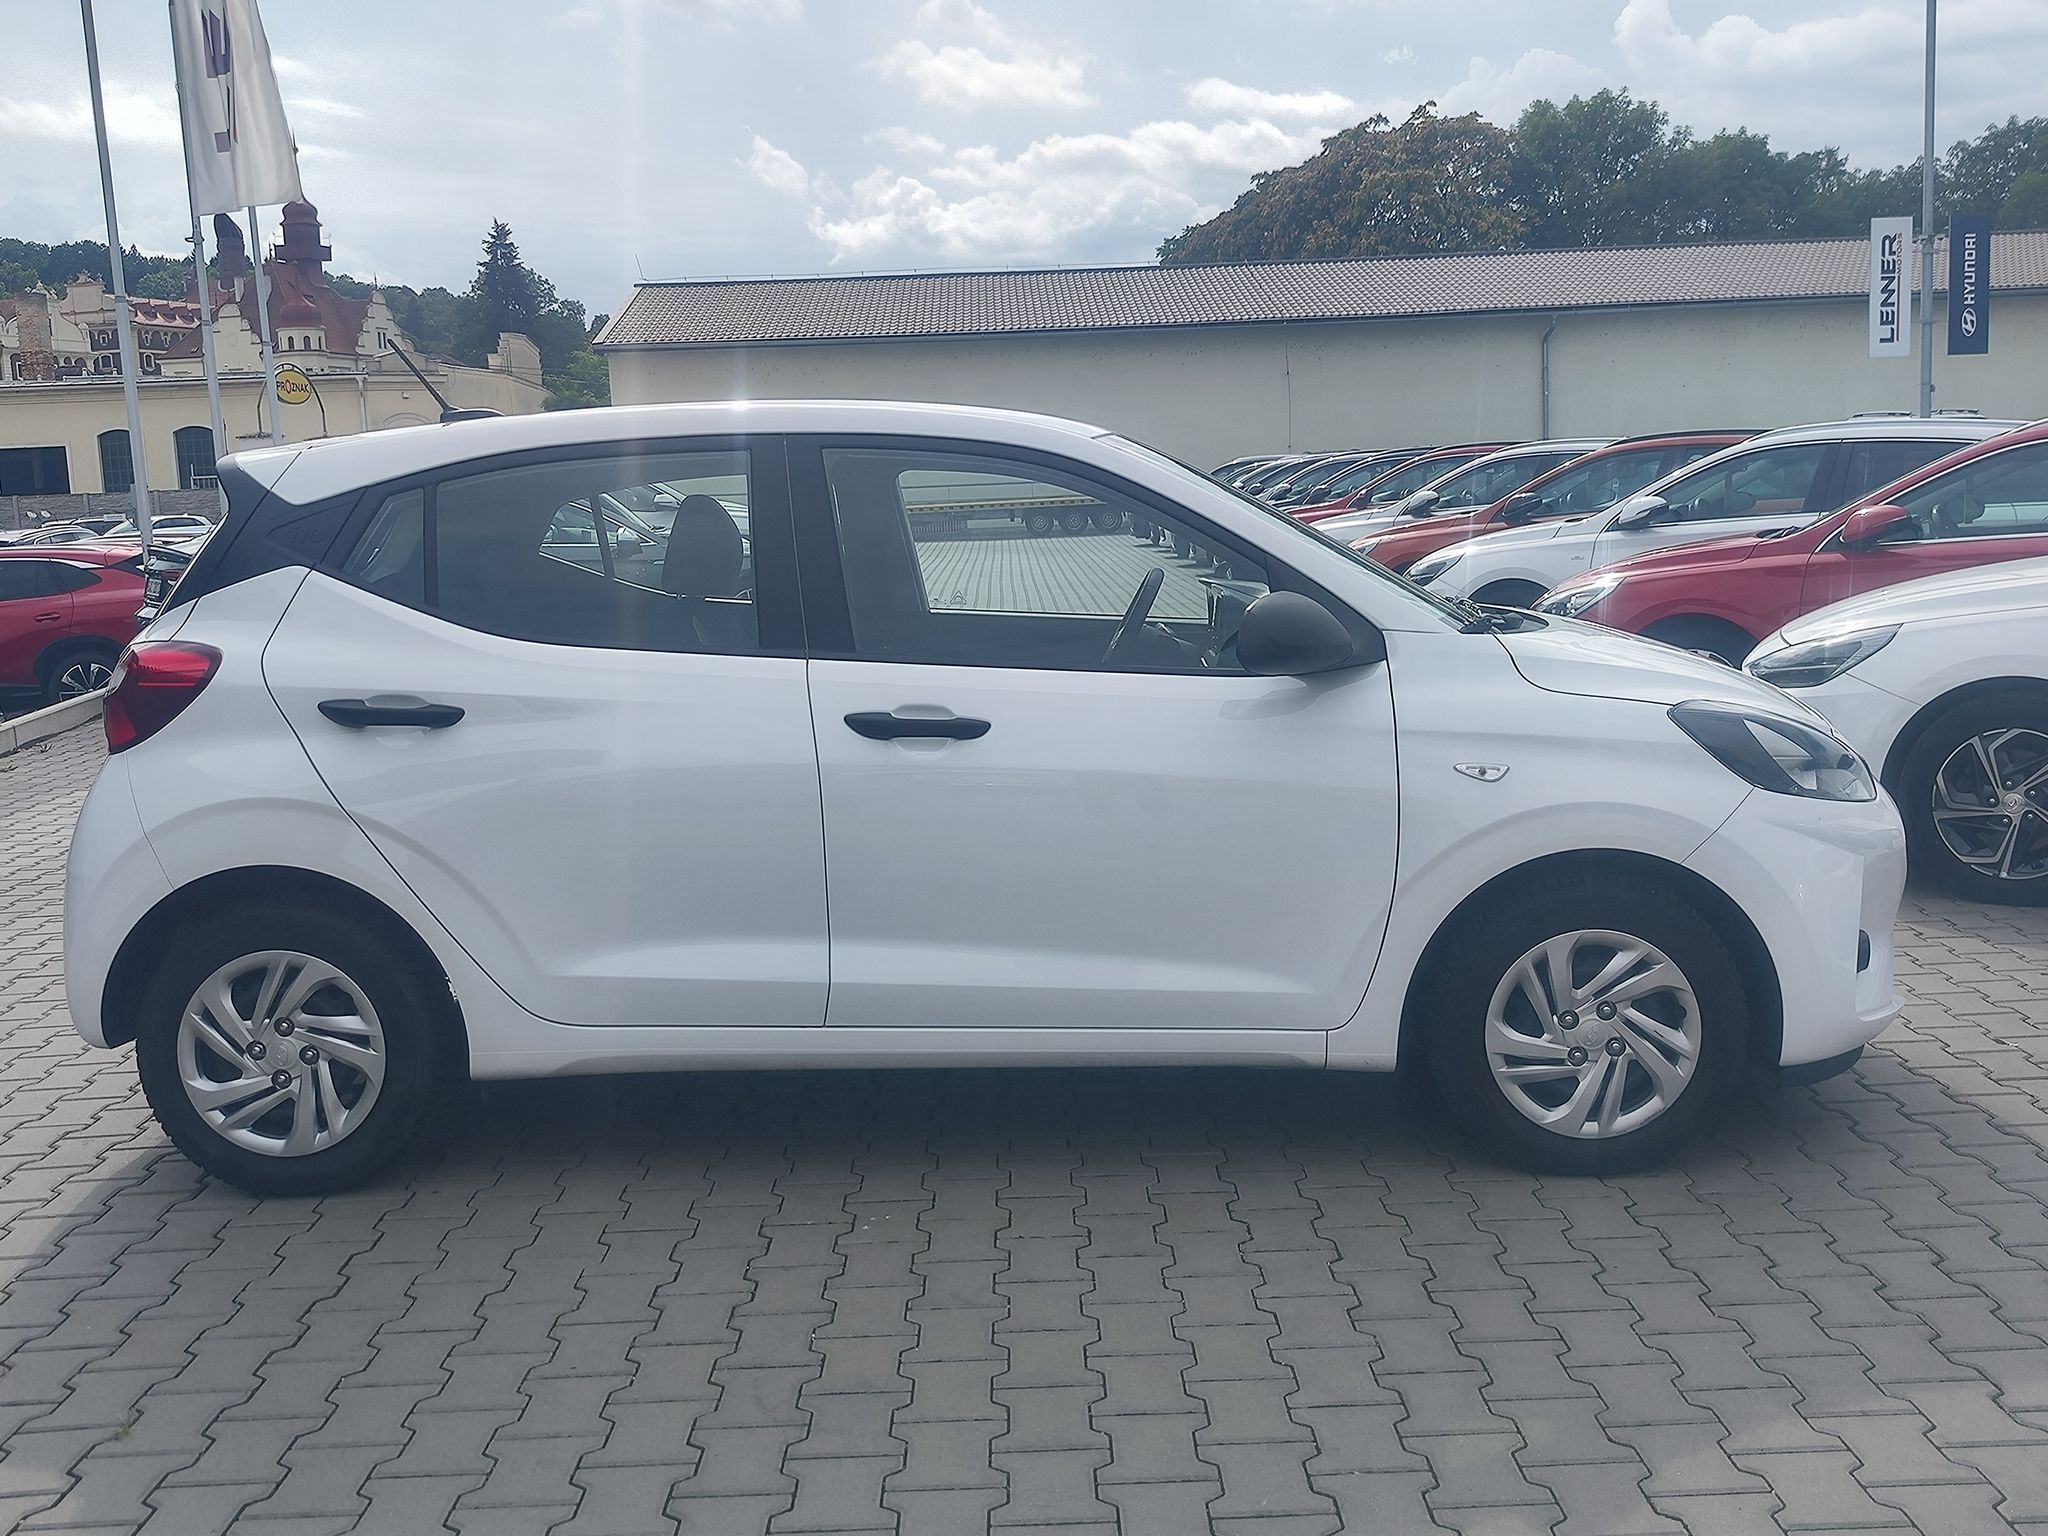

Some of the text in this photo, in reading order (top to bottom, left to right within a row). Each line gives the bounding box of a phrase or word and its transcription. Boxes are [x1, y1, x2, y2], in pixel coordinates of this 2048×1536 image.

[1879, 233, 1897, 343] LENNER
[1963, 233, 1976, 305] HYUNDAI
[276, 380, 309, 394] PROZNAK
